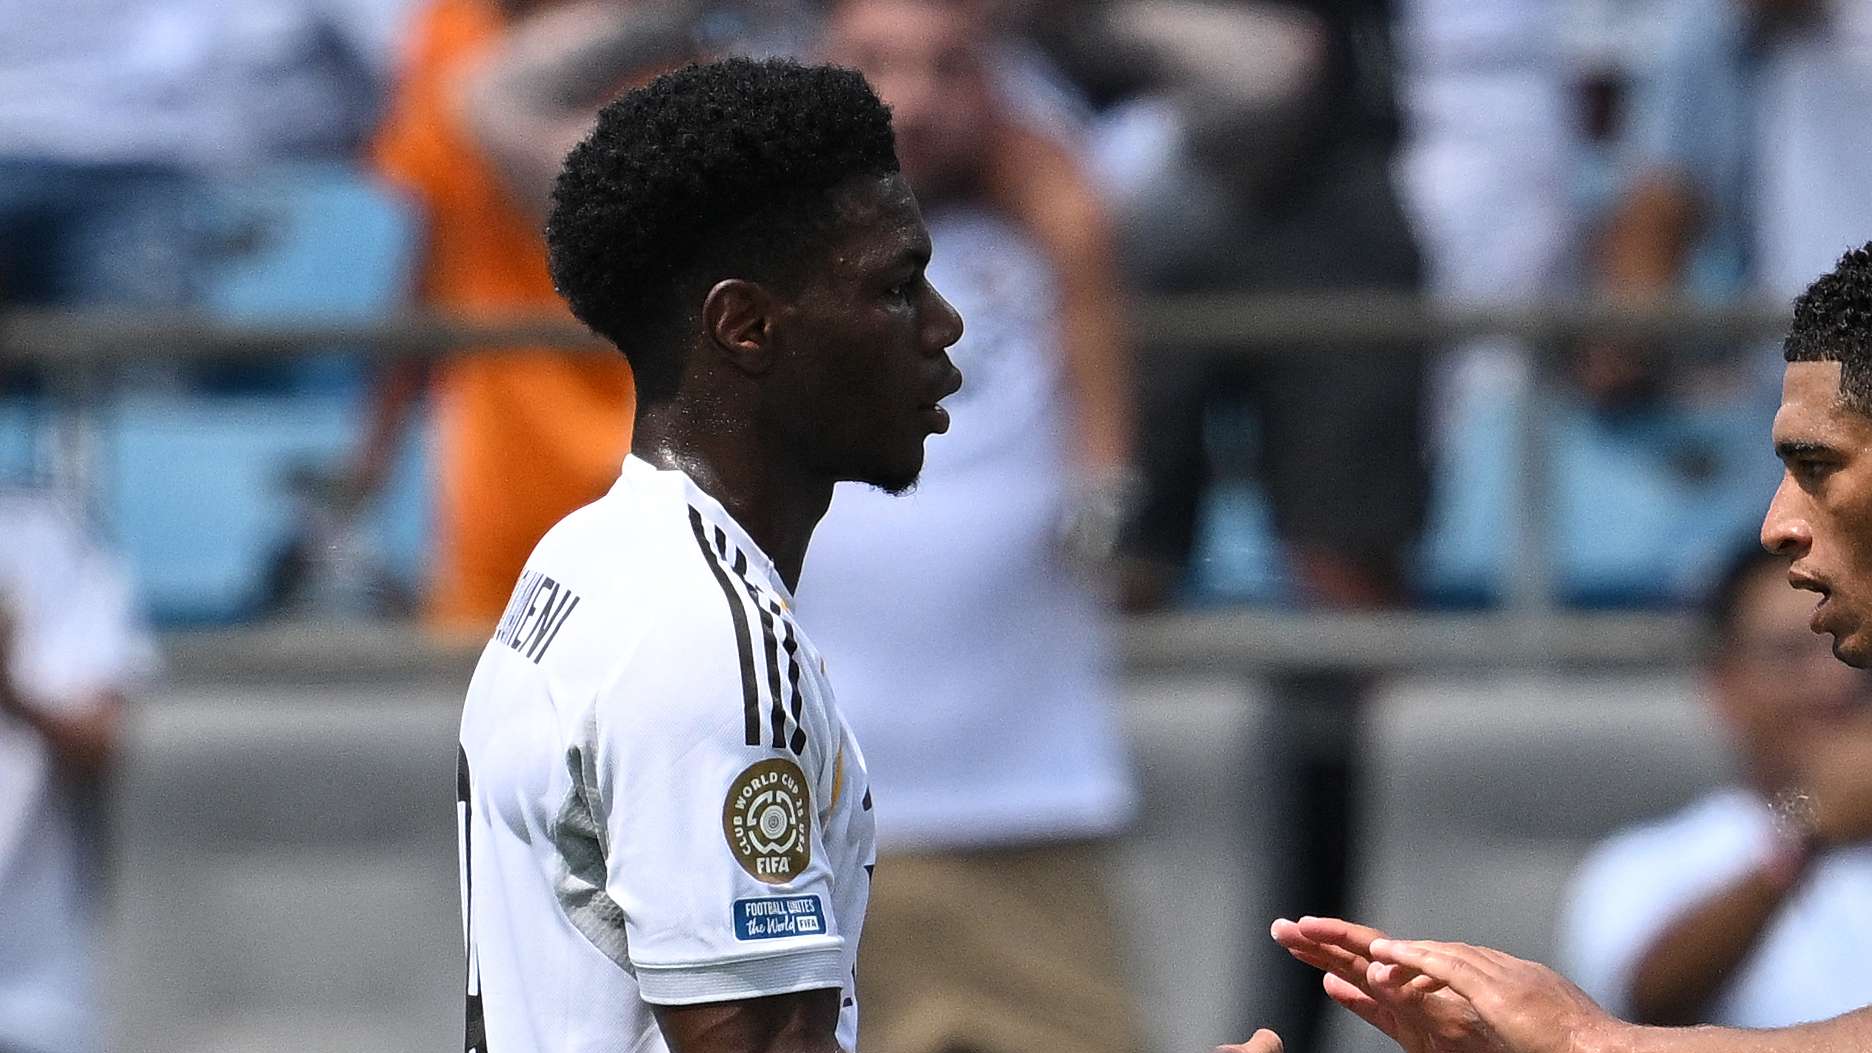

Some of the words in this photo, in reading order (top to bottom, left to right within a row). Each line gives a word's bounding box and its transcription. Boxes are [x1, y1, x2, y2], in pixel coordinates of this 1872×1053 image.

[735, 772, 778, 810] WORLD
[781, 773, 799, 795] CUP
[733, 815, 752, 855] CLUB
[756, 856, 790, 874] FIFA
[746, 917, 766, 935] the
[767, 915, 796, 934] World
[799, 919, 817, 928] FIFA
